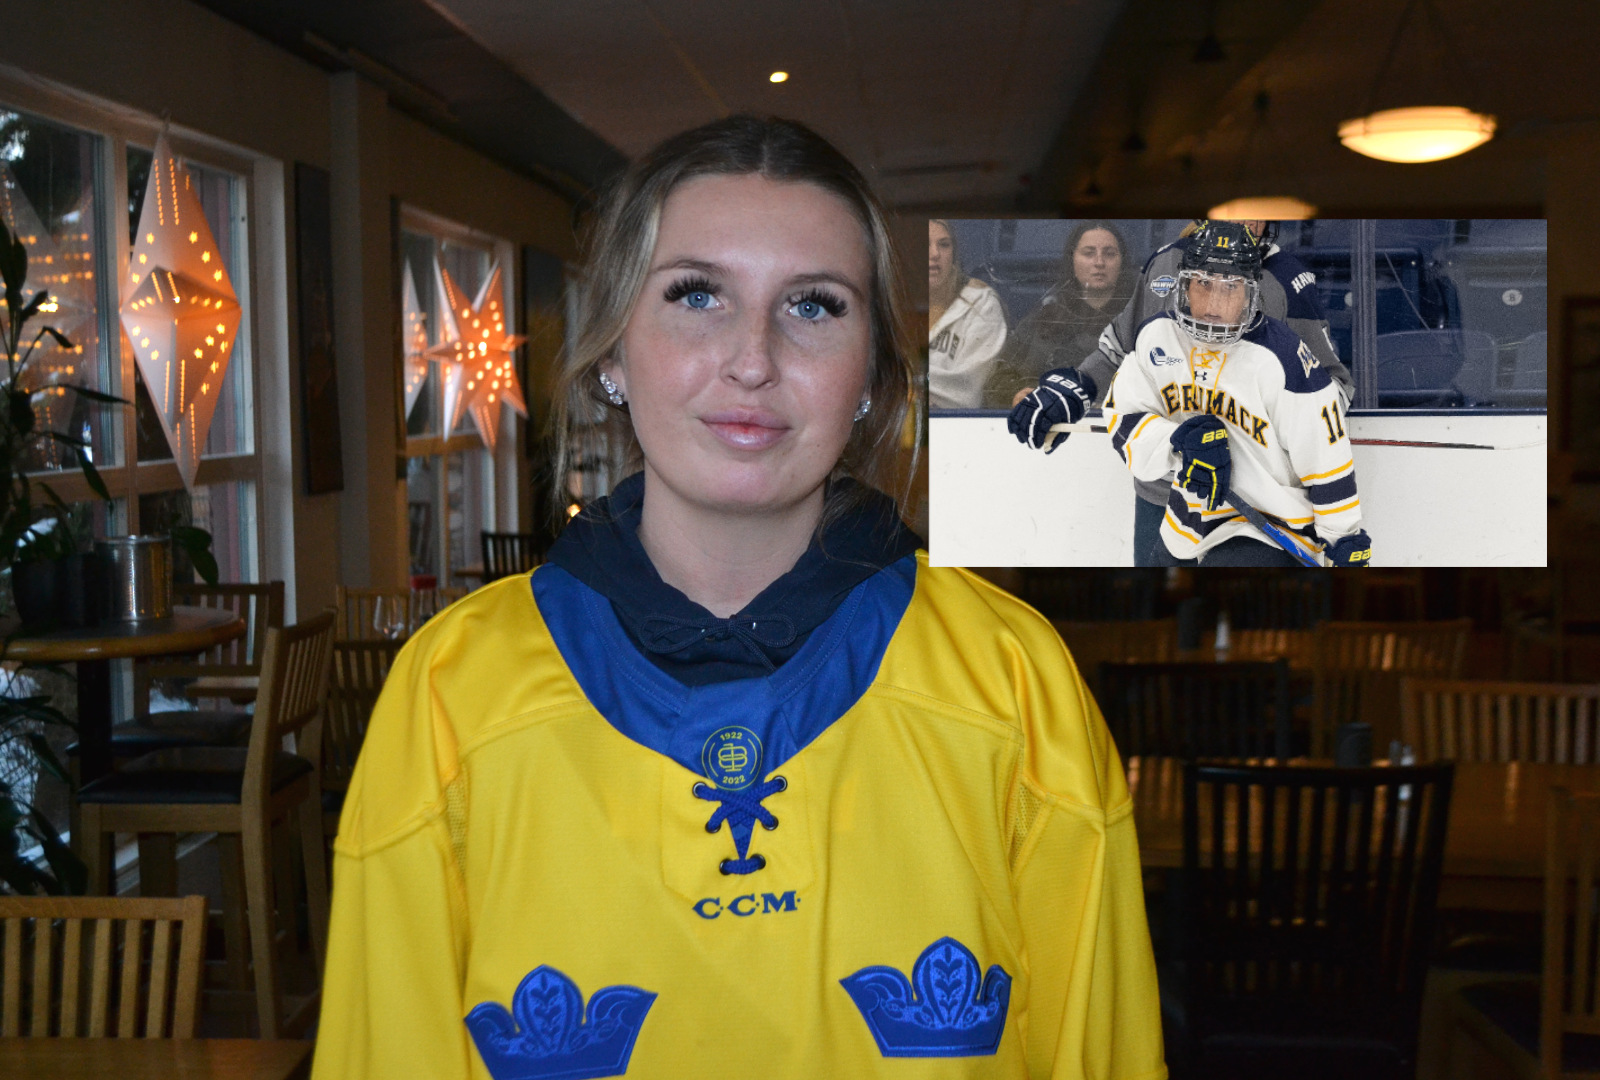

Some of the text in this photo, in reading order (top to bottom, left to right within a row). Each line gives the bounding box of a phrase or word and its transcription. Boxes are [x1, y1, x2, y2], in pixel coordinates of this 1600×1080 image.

[1216, 236, 1229, 248] 11
[1321, 400, 1345, 445] 11
[720, 731, 743, 741] 1922
[722, 775, 746, 784] 2022
